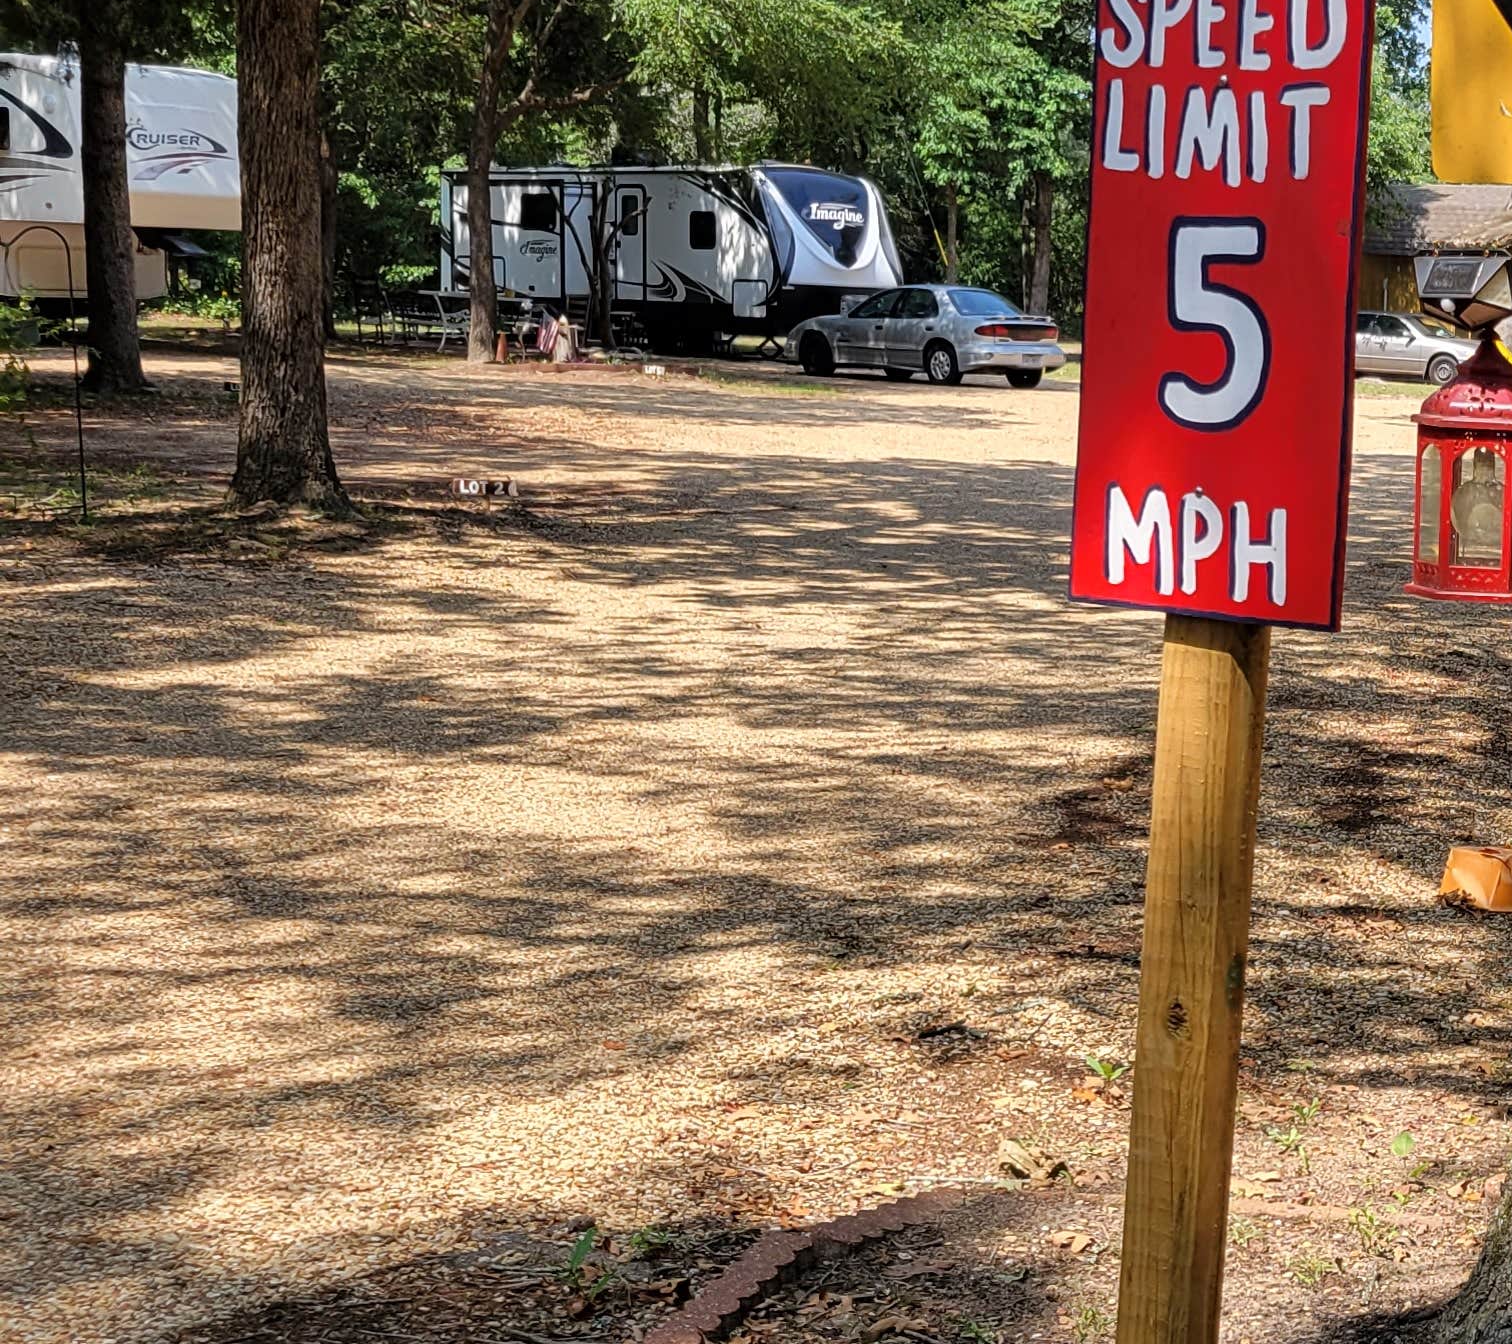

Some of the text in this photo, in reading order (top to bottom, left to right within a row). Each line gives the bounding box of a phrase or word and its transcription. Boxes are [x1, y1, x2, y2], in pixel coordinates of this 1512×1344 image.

[127, 127, 201, 151] CRUISER
[1101, 78, 1331, 188] LIMIT
[809, 202, 864, 230] Imagine
[1158, 216, 1272, 432] 5
[459, 479, 489, 495] LOT
[1104, 482, 1288, 607] MPH
